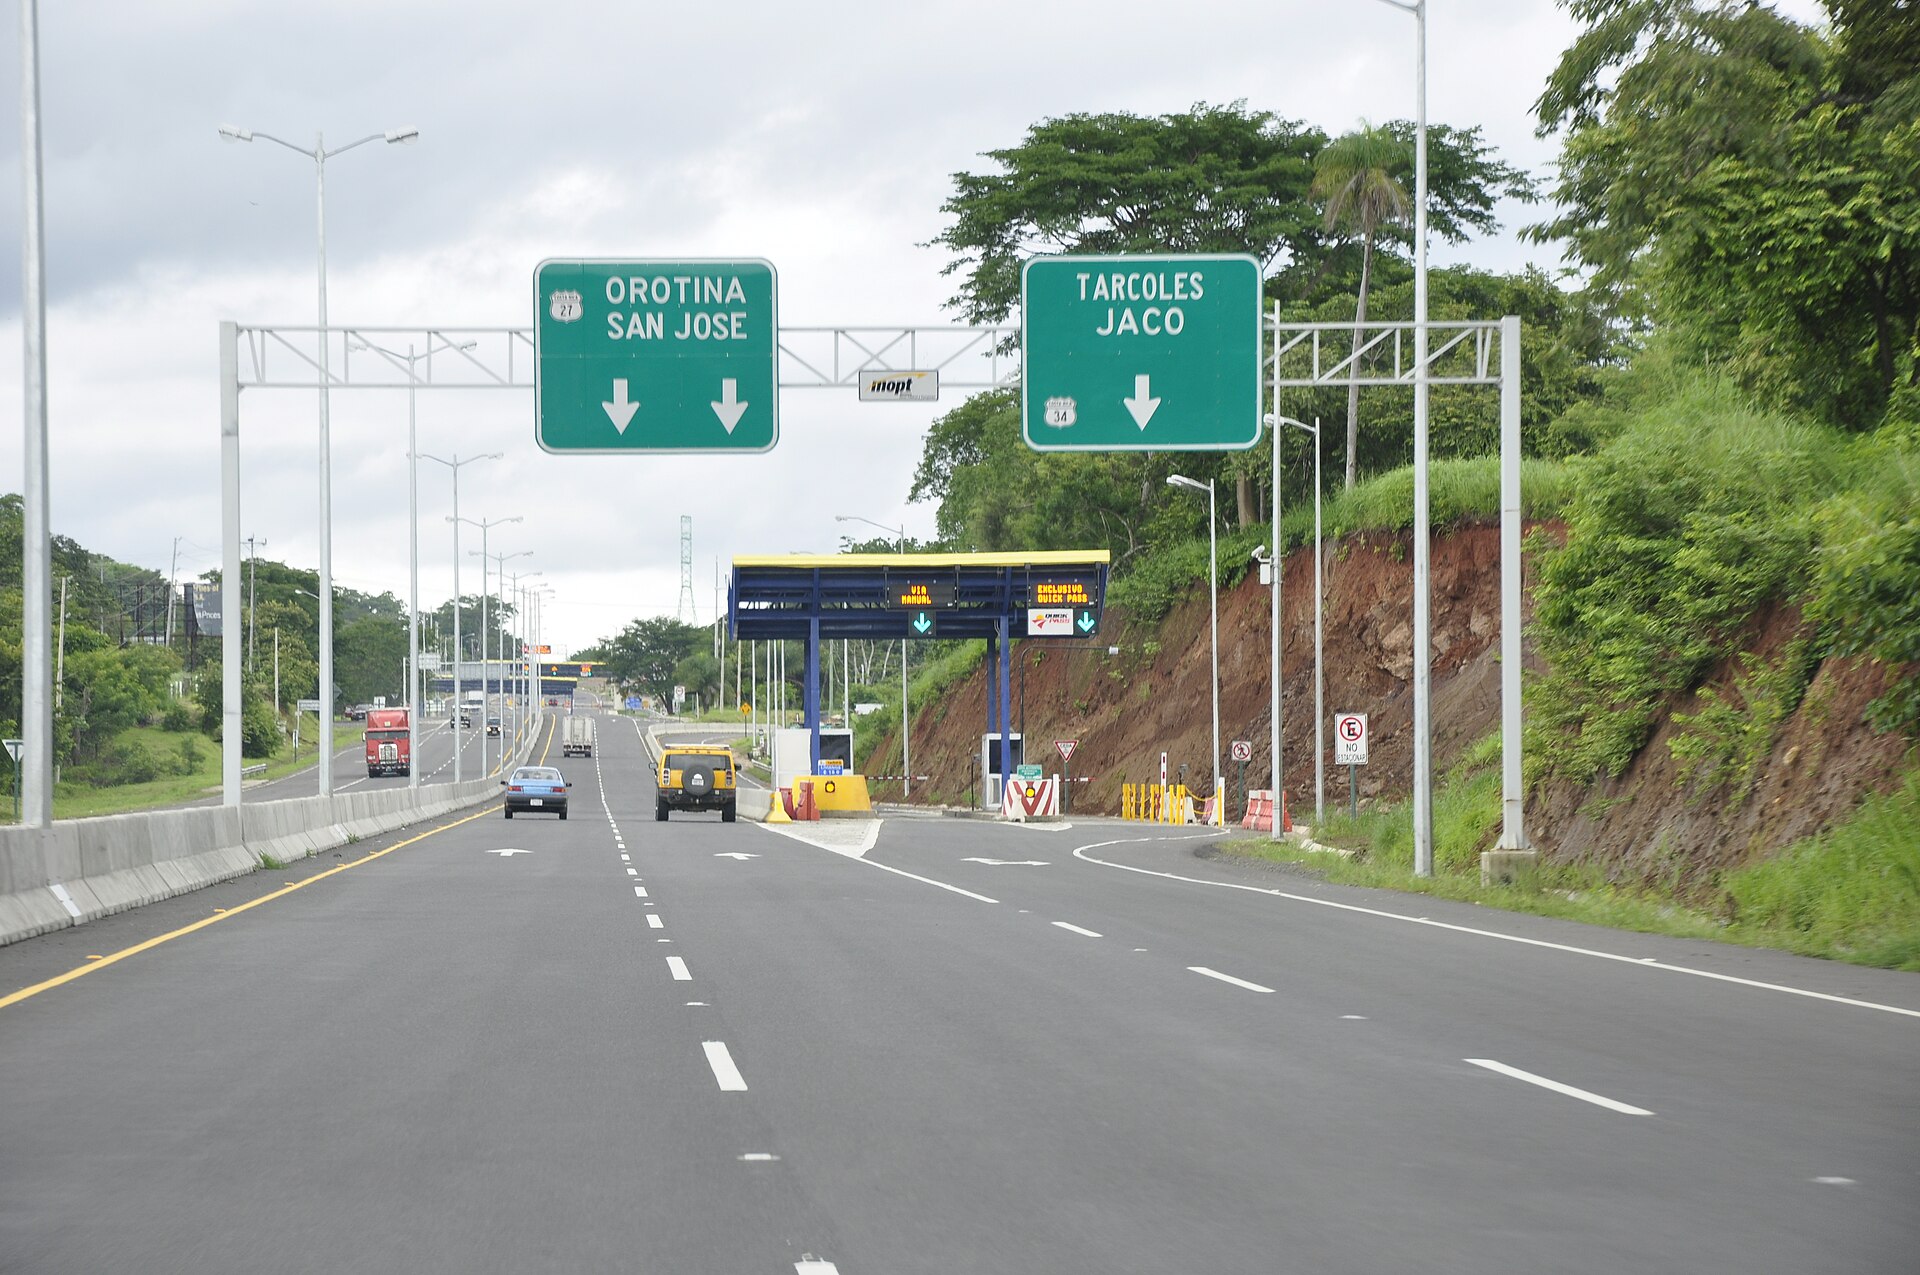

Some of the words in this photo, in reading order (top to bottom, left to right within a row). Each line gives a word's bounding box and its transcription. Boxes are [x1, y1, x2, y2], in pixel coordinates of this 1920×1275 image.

[605, 275, 747, 305] OROTINA
[1077, 272, 1204, 302] TARCOLES
[560, 304, 573, 317] 27
[607, 312, 664, 340] SAN
[674, 312, 748, 340] JOSE
[1096, 306, 1185, 336] JACO
[870, 377, 913, 395] mopt
[1054, 411, 1067, 423] 34
[911, 585, 927, 595] VIA
[1037, 584, 1083, 594] EXCLUSIVO
[901, 595, 932, 605] MANUAL
[1038, 594, 1063, 603] QUICK
[1067, 593, 1088, 603] PASS
[1346, 743, 1358, 752] NO
[1337, 754, 1366, 763] ESTACIONAR
